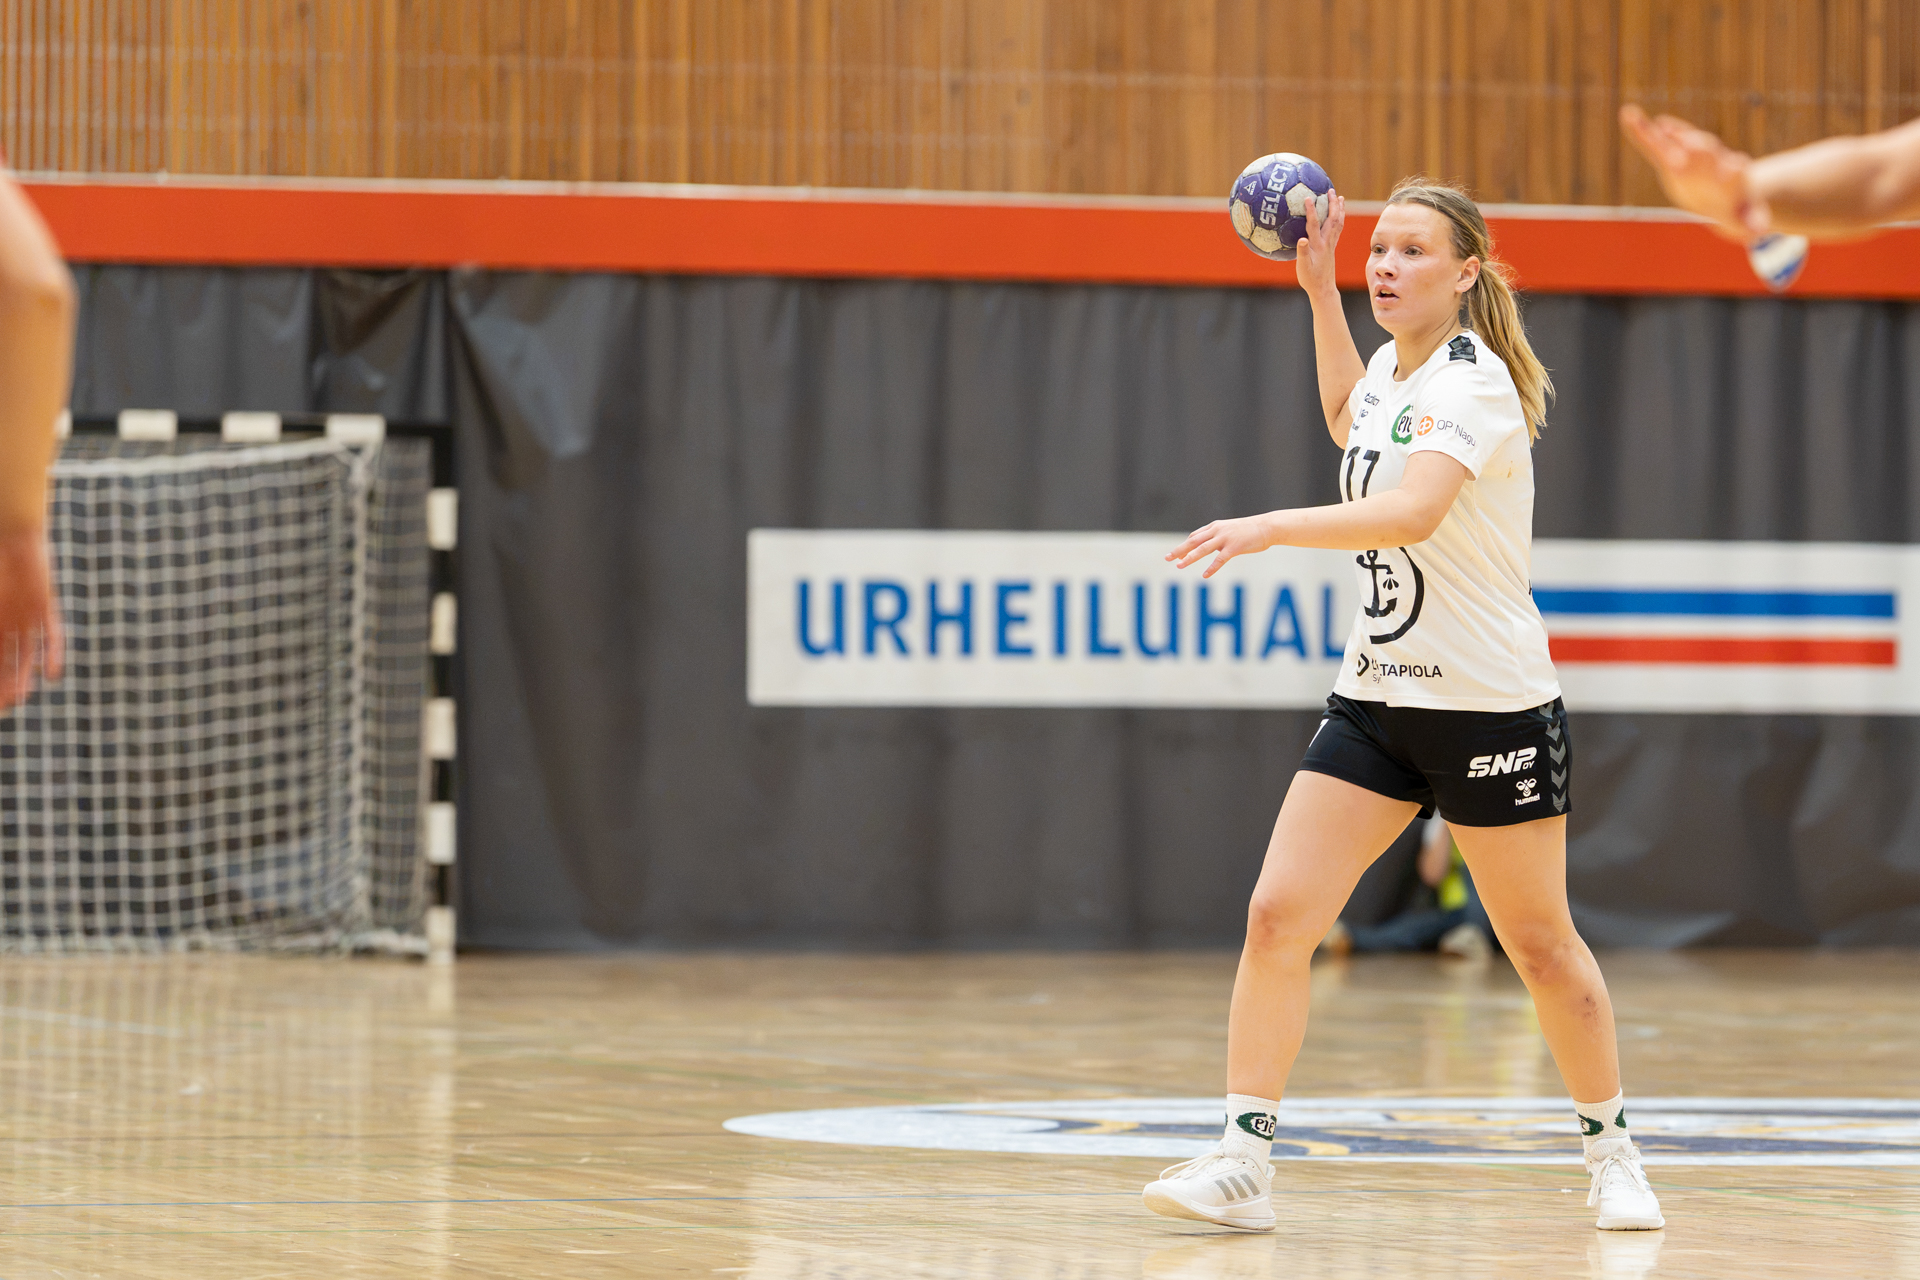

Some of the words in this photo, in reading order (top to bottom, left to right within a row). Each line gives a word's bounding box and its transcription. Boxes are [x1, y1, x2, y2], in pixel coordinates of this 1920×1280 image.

[1260, 163, 1291, 226] SELECT
[1437, 419, 1453, 430] OP
[1346, 446, 1381, 502] 17
[1467, 746, 1537, 778] SNP
[1522, 760, 1535, 770] OY
[1514, 792, 1541, 806] hummel
